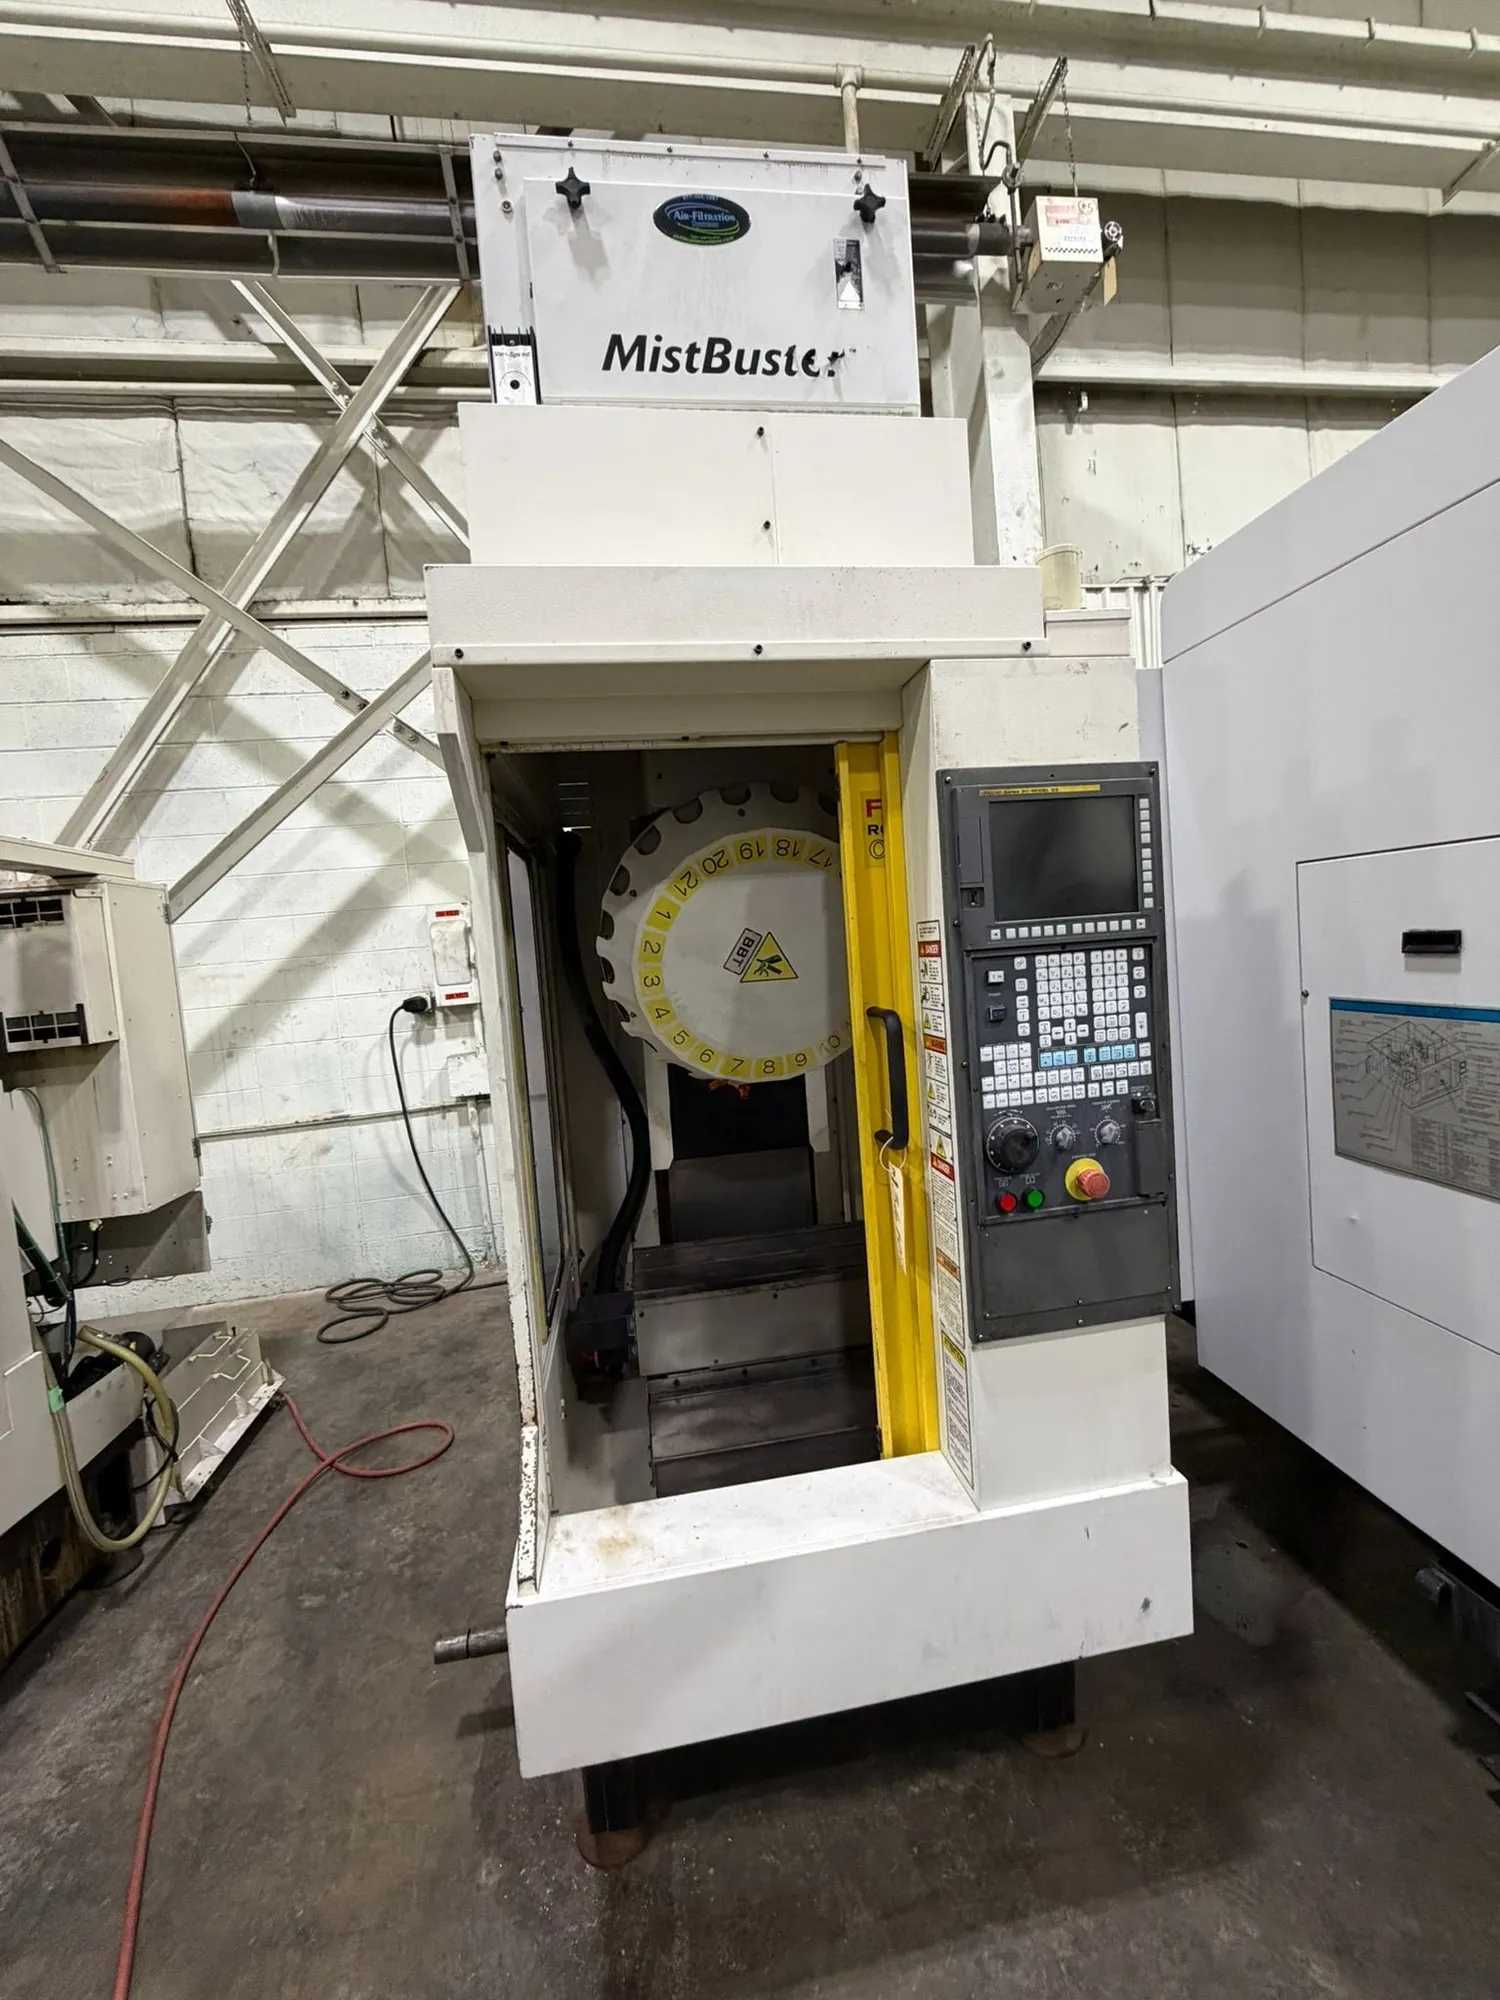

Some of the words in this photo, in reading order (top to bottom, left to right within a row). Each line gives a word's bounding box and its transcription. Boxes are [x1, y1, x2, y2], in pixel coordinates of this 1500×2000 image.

[739, 839, 765, 860] 19
[775, 838, 801, 858] 18
[702, 849, 730, 875] 20
[673, 870, 699, 897] 21
[655, 910, 672, 920] 1
[643, 940, 661, 954] 2
[733, 936, 756, 968] BBT
[643, 975, 661, 988] 3
[655, 1007, 671, 1020] 4
[673, 1029, 690, 1045] 5
[699, 1048, 715, 1064] 6
[794, 1052, 808, 1067] 9
[731, 1057, 745, 1073] 7
[762, 1059, 776, 1074] 8
